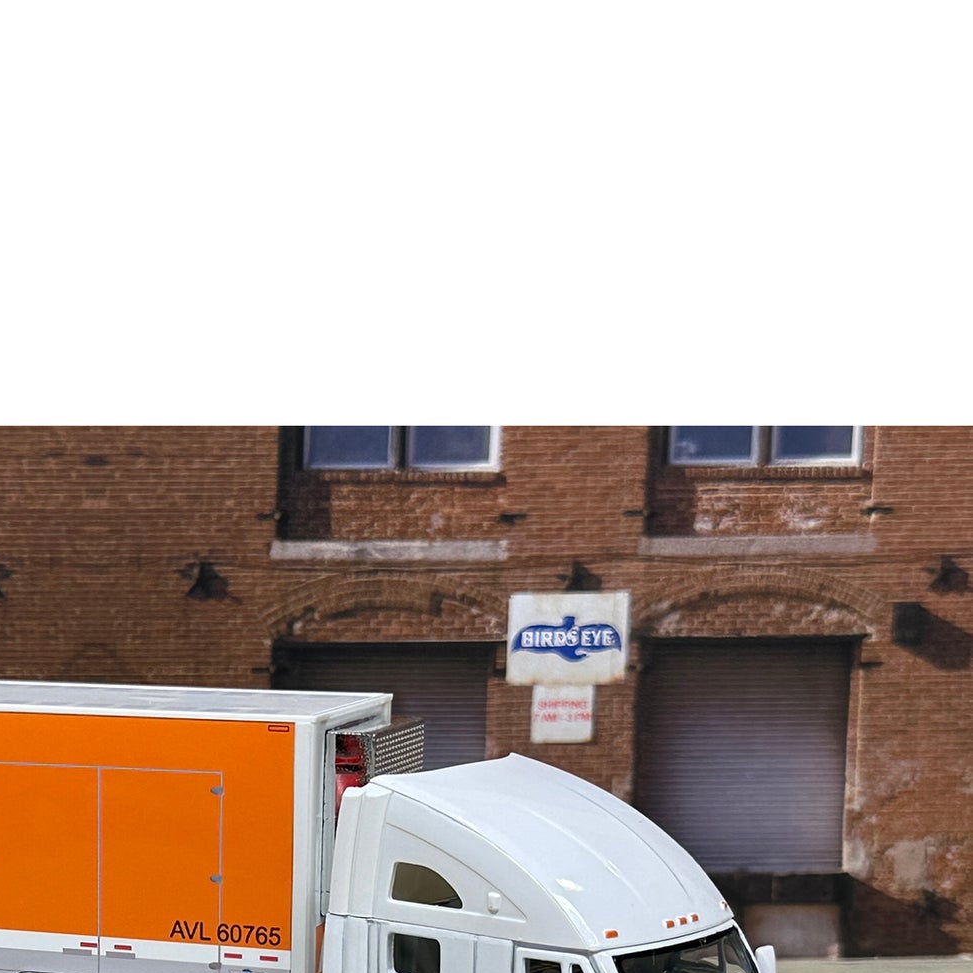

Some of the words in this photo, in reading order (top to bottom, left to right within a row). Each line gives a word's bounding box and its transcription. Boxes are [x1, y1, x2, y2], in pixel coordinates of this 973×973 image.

[521, 629, 580, 648] BIRDS
[581, 630, 615, 647] EYE
[169, 920, 211, 941] AVL
[217, 923, 281, 946] 60765
